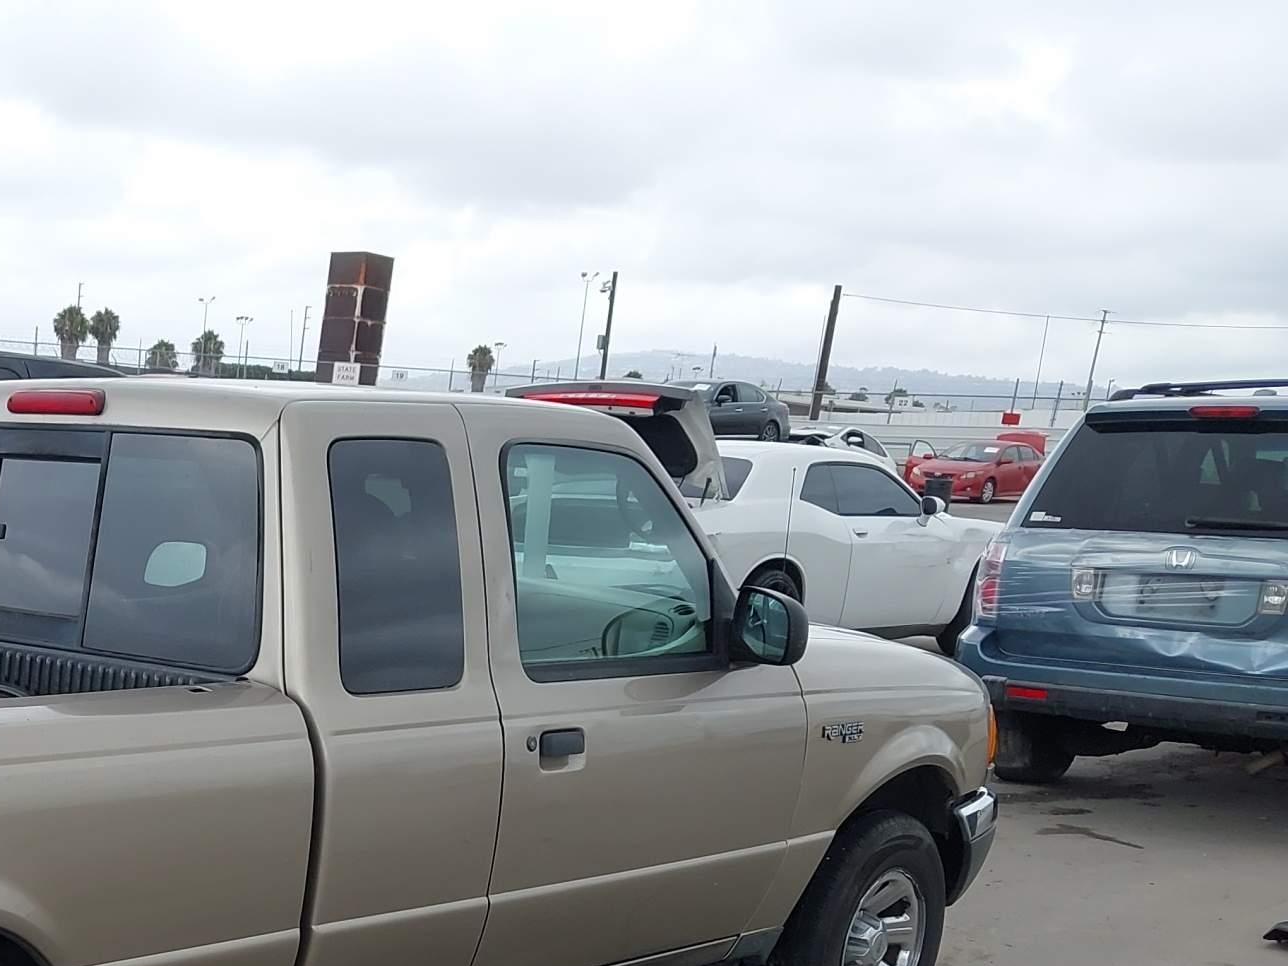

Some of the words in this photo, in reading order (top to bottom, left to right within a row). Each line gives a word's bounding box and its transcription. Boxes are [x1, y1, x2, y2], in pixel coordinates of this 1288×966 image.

[337, 364, 357, 373] STATE
[335, 373, 355, 381] FARM
[899, 399, 908, 407] 22
